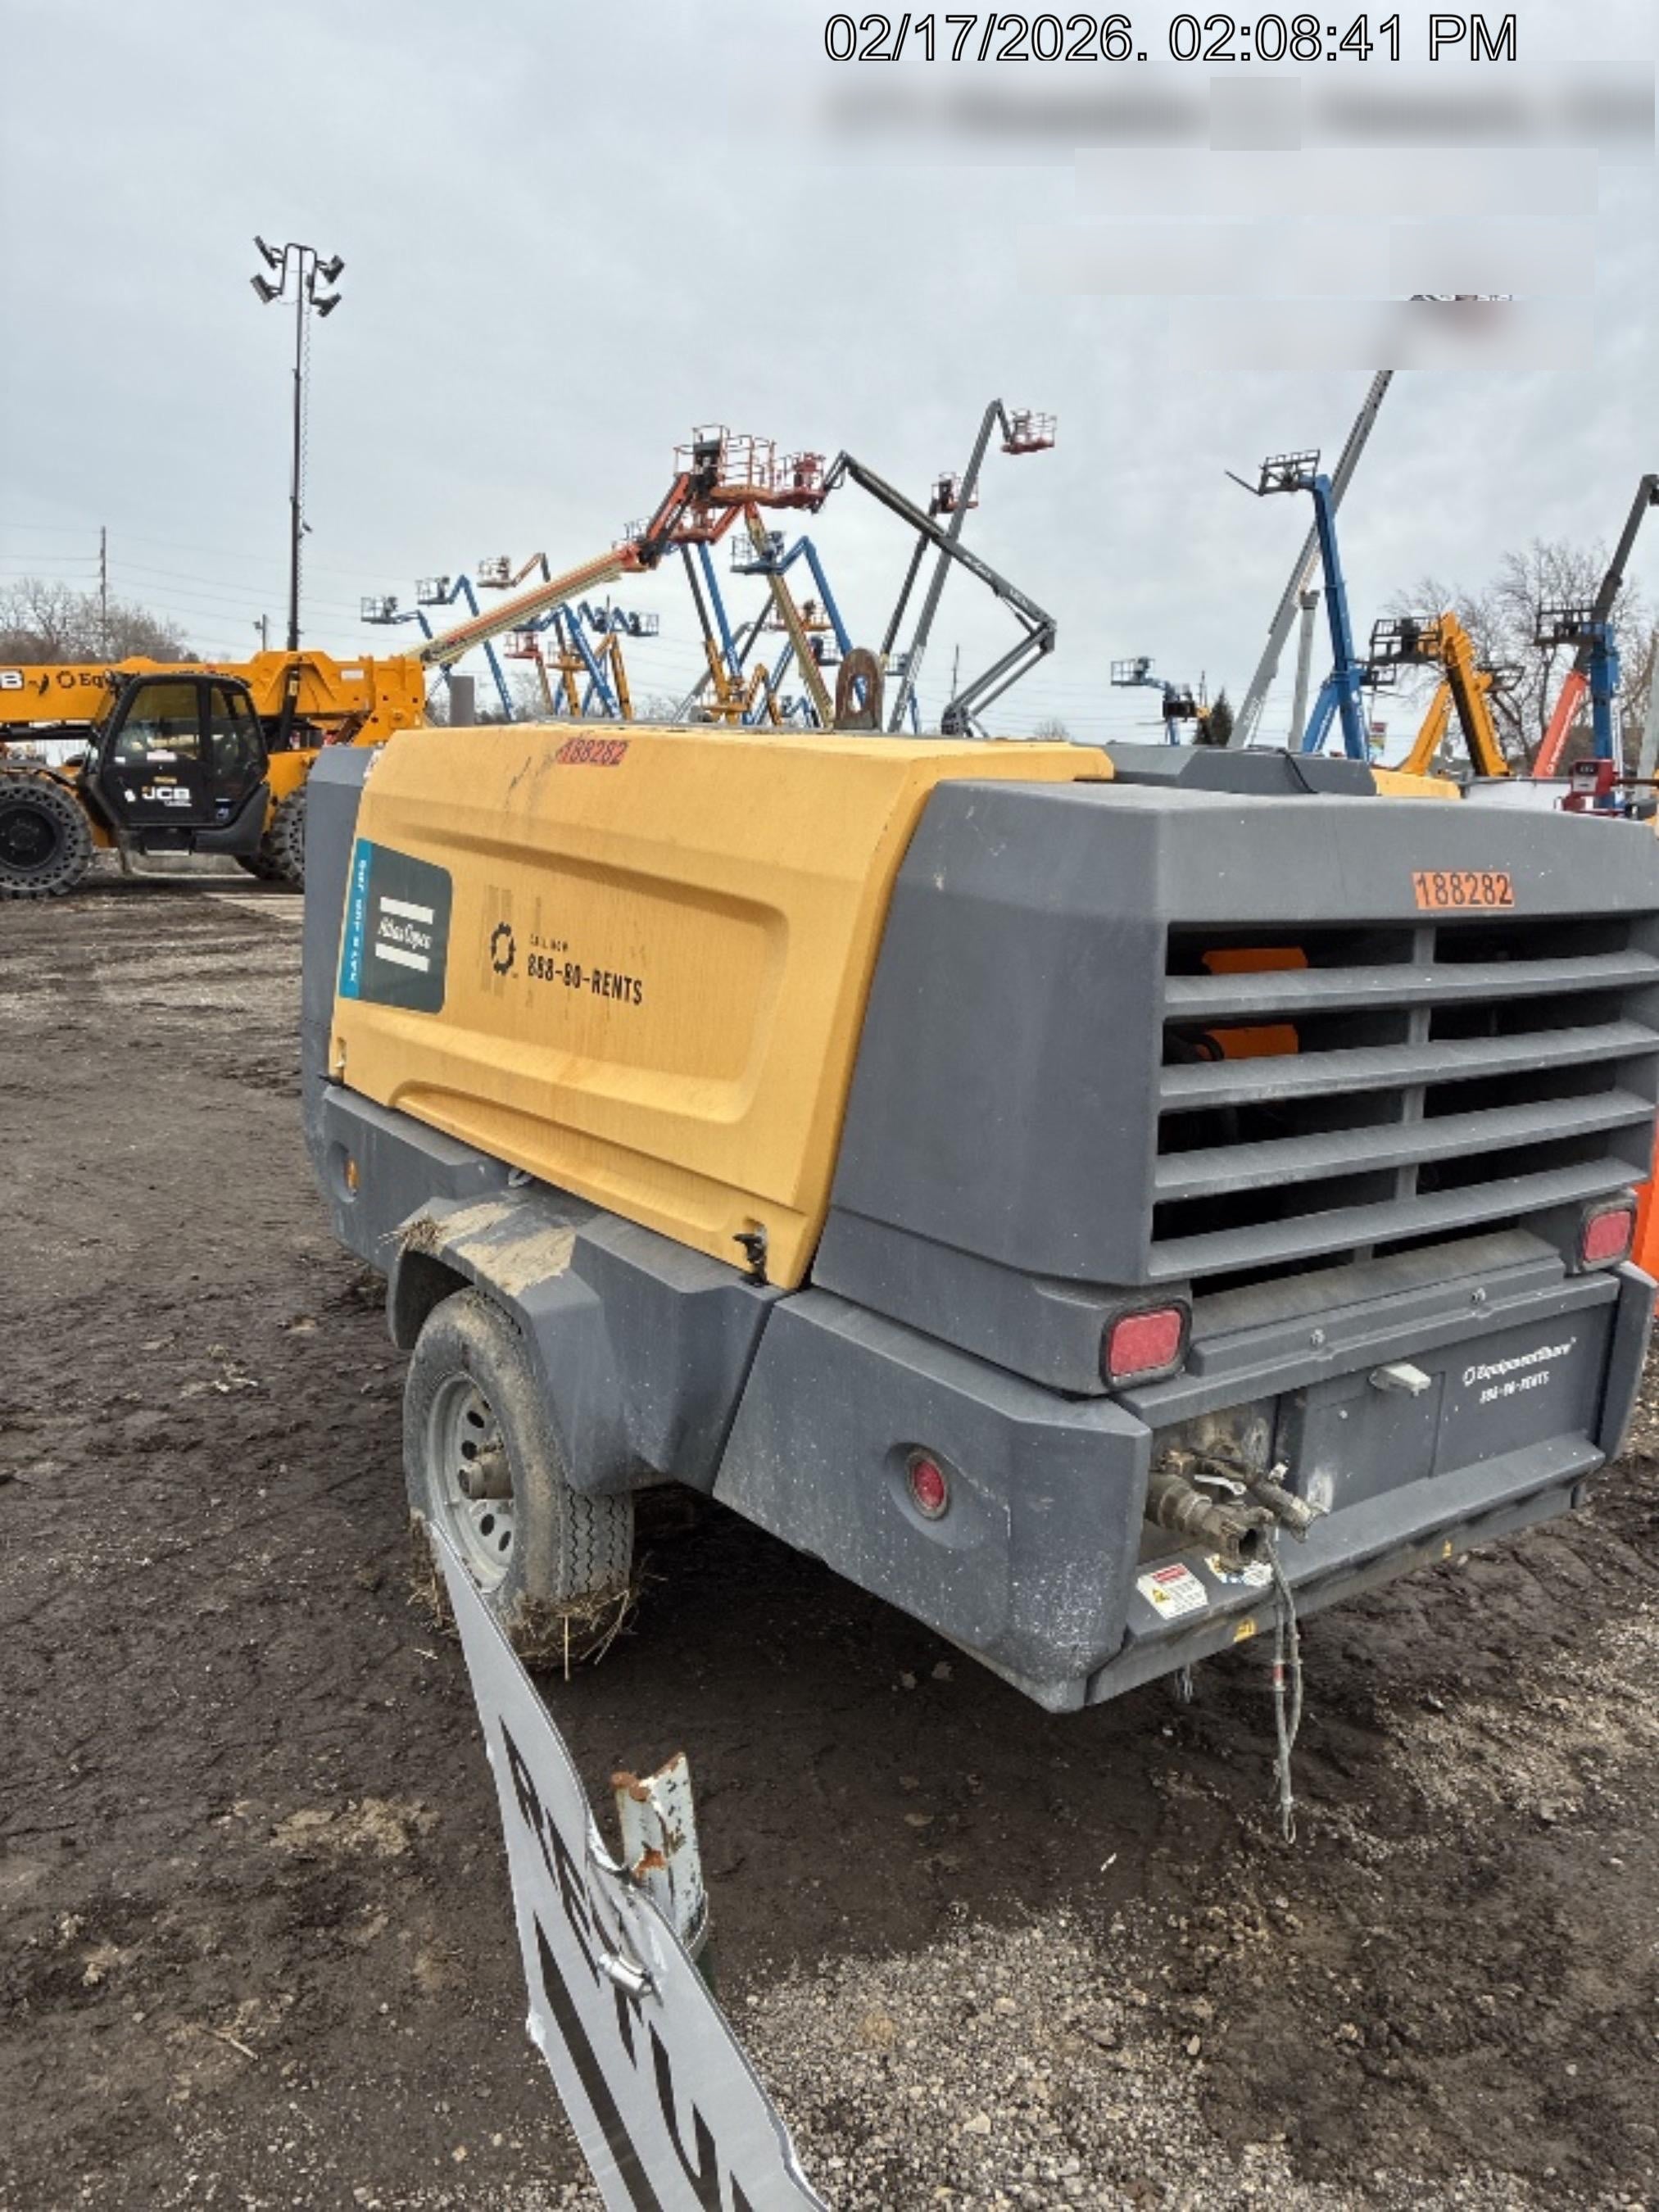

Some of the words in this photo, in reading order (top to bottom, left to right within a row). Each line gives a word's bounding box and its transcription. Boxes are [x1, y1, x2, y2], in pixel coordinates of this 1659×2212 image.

[560, 739, 629, 765] 188282
[142, 786, 190, 800] JCB
[1416, 873, 1512, 905] 188282
